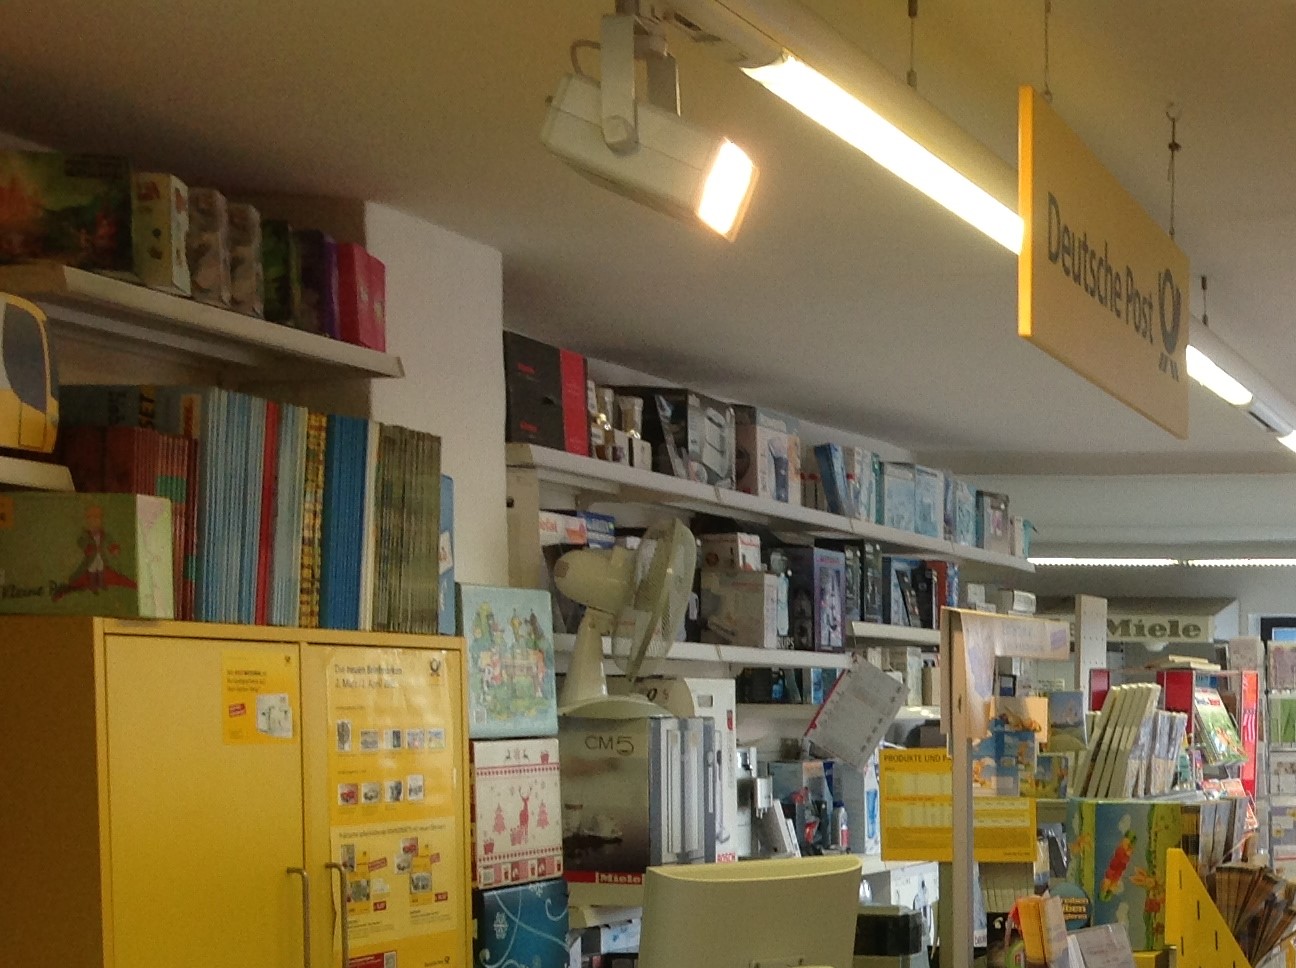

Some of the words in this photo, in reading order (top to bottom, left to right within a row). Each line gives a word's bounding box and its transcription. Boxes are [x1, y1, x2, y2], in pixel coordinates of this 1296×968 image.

[1047, 190, 1122, 319] Deutsche
[1125, 265, 1154, 345] Post
[1107, 618, 1202, 640] Miele
[584, 734, 635, 757] CM5
[883, 754, 923, 763] PRODUKTE
[924, 755, 941, 763] UND
[598, 873, 642, 885] Miele
